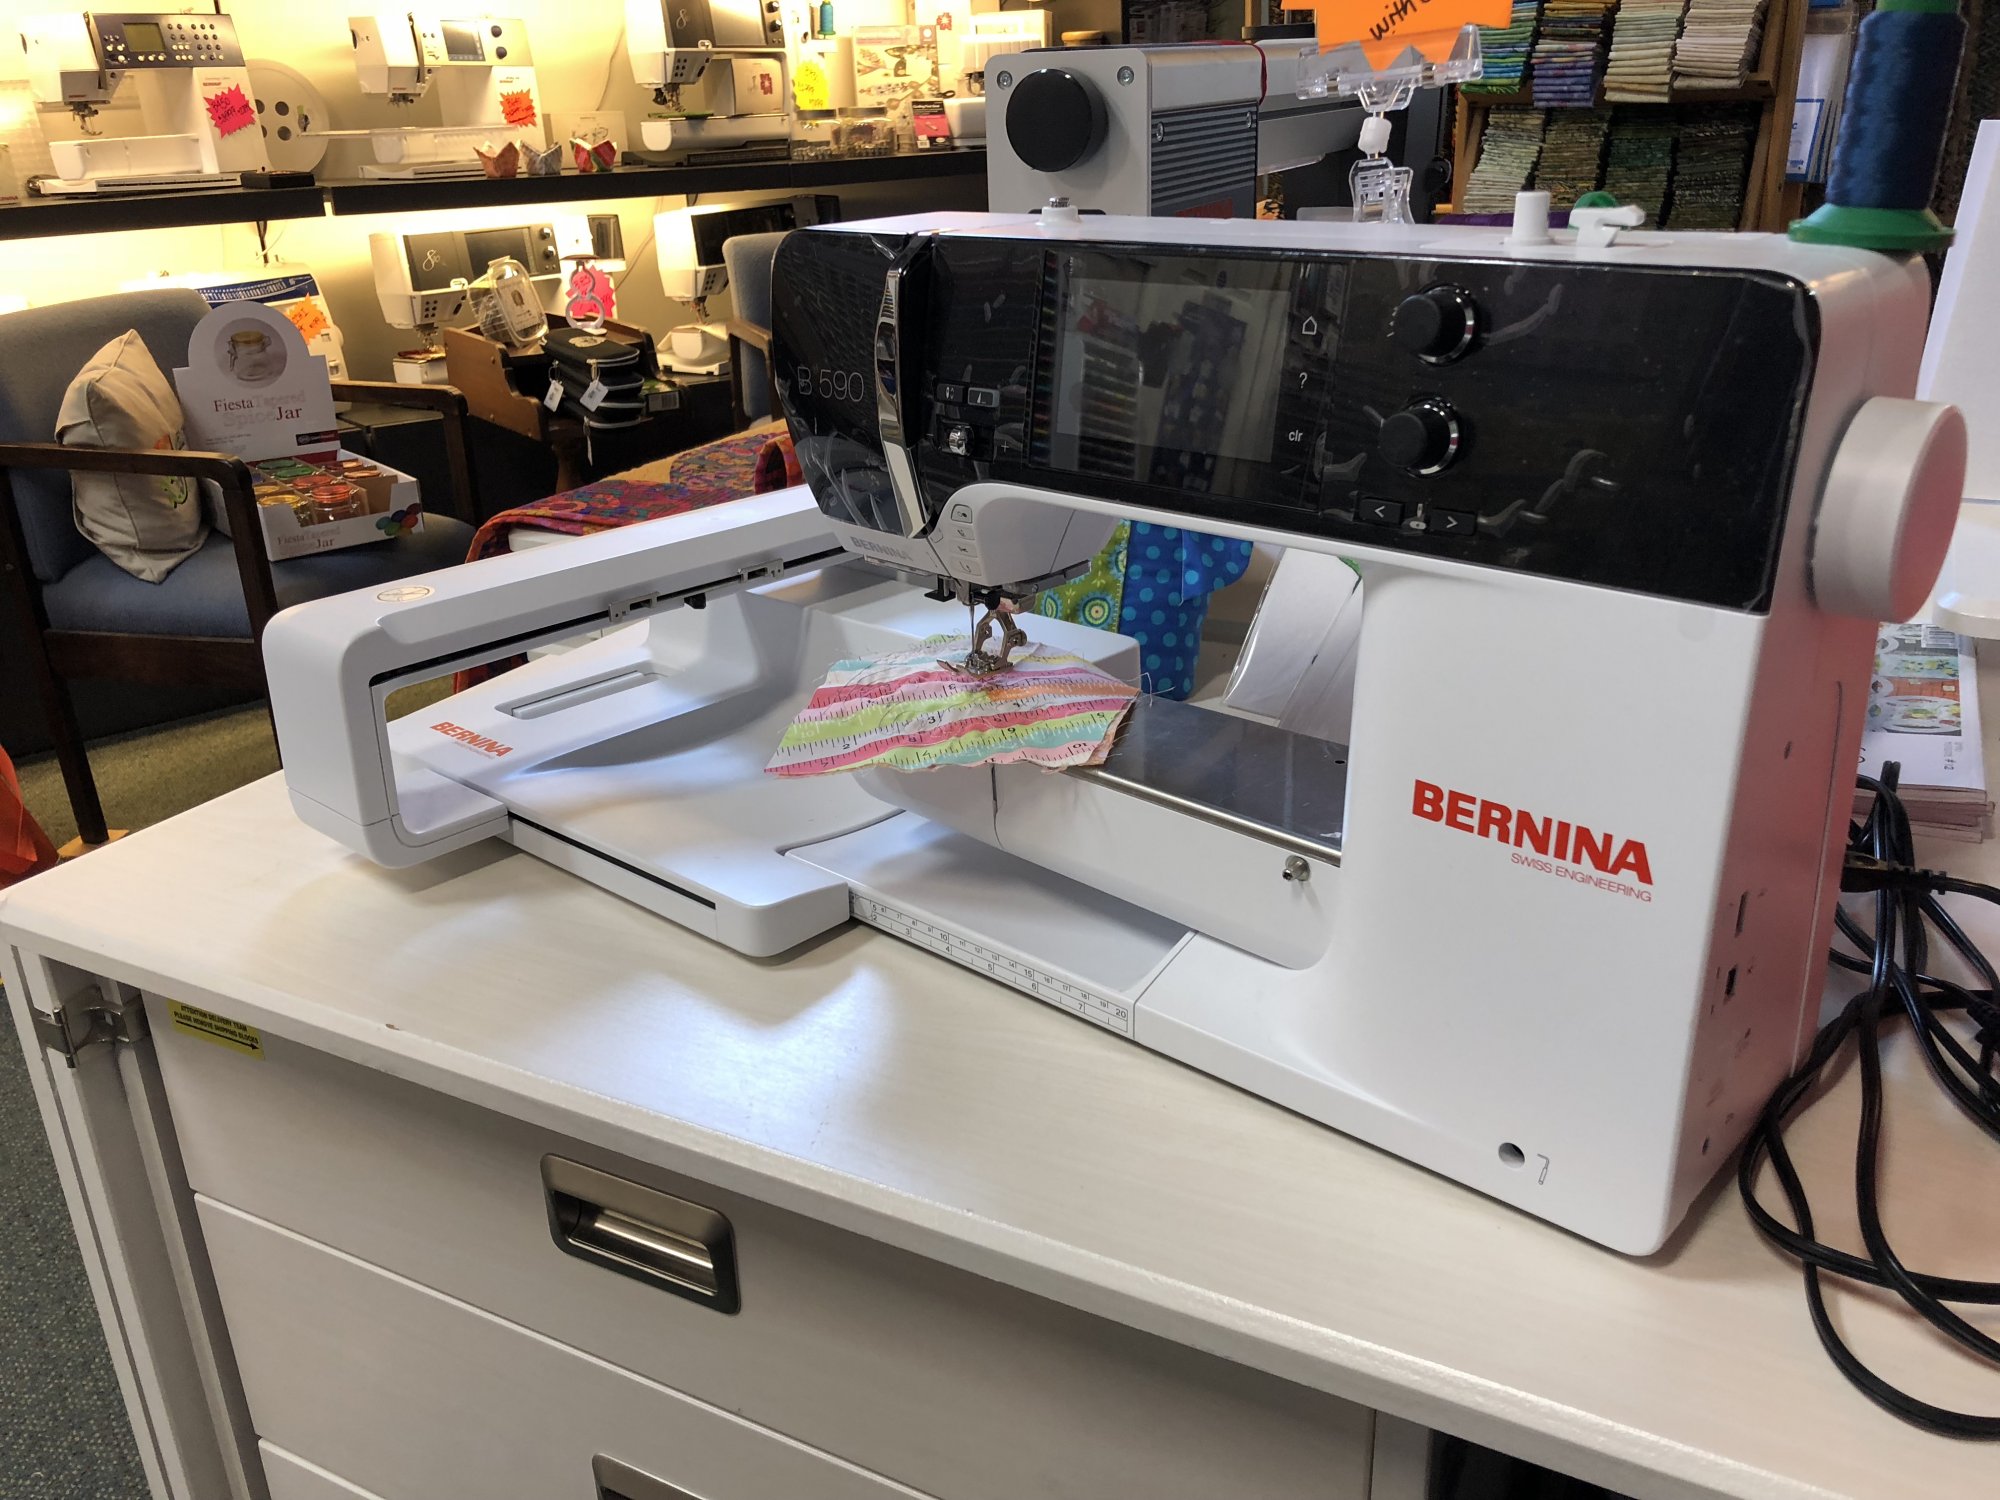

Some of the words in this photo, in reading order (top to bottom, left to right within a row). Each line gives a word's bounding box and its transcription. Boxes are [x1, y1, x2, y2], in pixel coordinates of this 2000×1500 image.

[1369, 0, 1417, 41] with
[797, 366, 812, 395] B
[819, 369, 864, 402] 590
[213, 397, 254, 413] Fiesta
[275, 405, 302, 422] Jar
[1288, 429, 1303, 442] clr
[928, 715, 936, 724] 3
[430, 721, 514, 757] BERNINA
[1411, 778, 1654, 886] BERNINA
[1510, 852, 1553, 875] SWISS
[1554, 864, 1653, 903] ENGINEERING
[905, 928, 910, 936] 3
[945, 945, 951, 953] 4
[987, 963, 993, 972] 5
[1031, 982, 1037, 990] 6
[1078, 1002, 1083, 1011] 7
[940, 932, 949, 941] 10
[1024, 969, 1033, 979] 15
[1100, 1000, 1107, 1008] 19
[1115, 1008, 1127, 1019] 20
